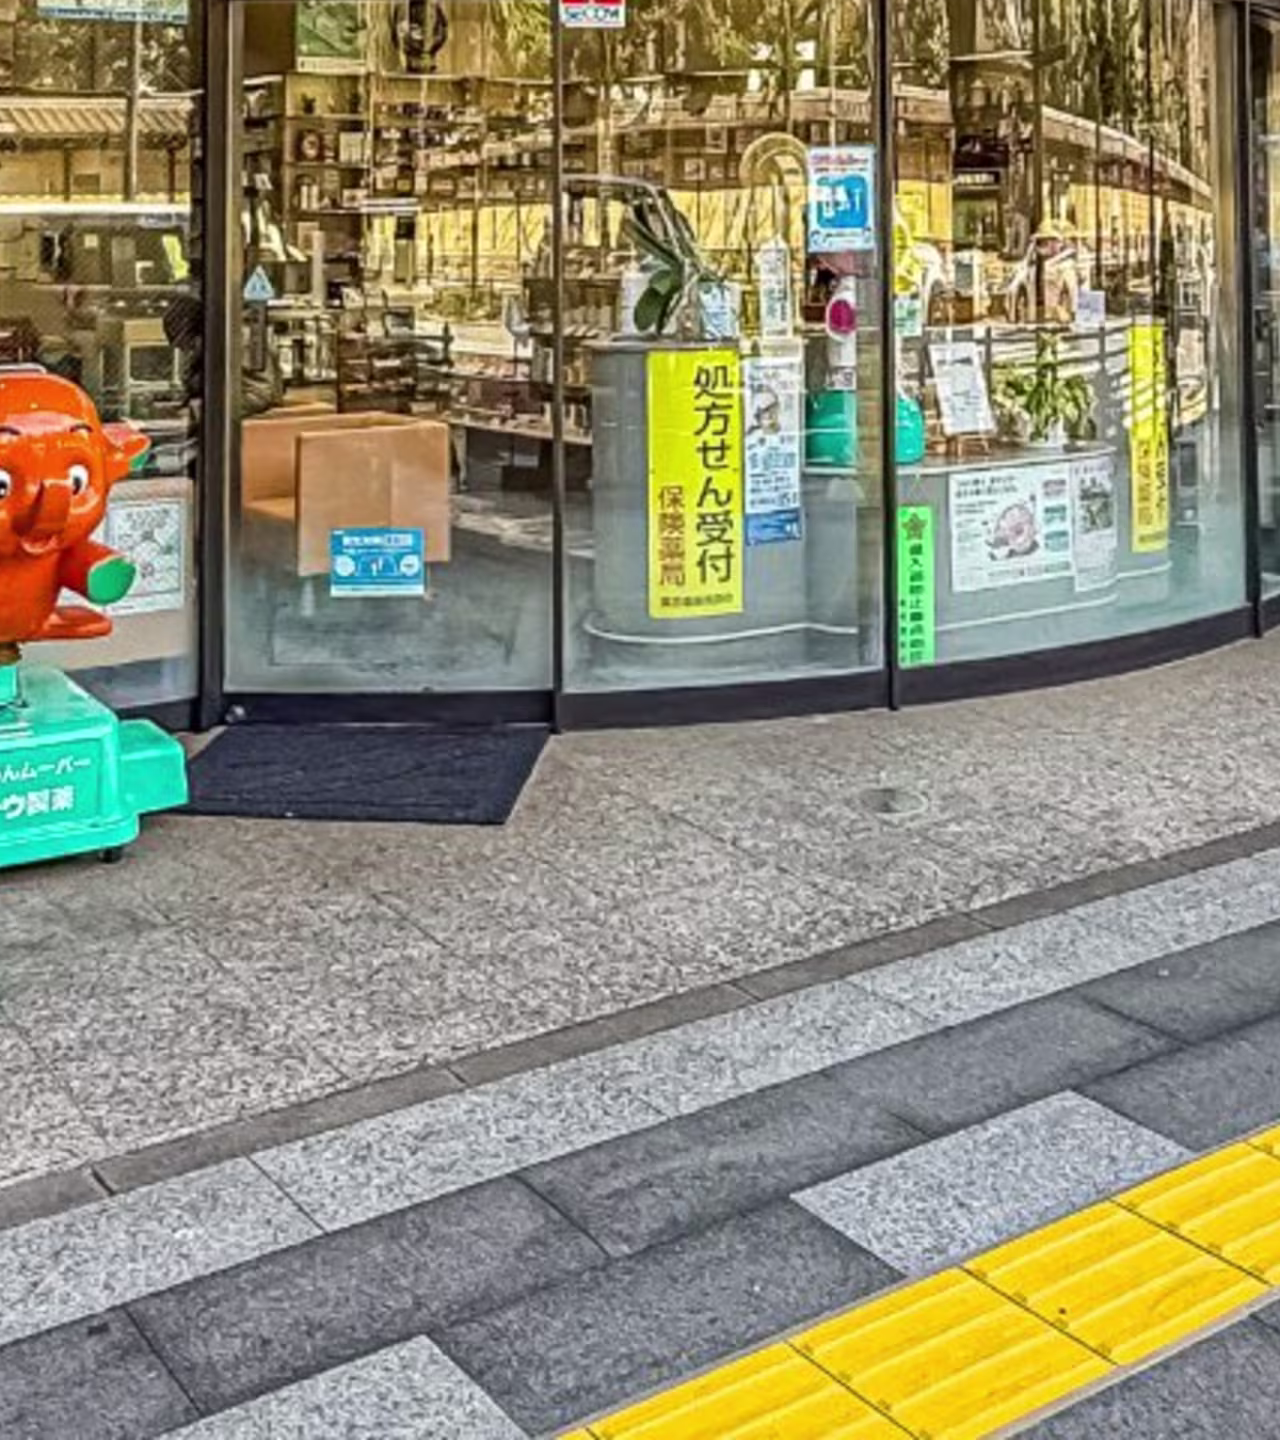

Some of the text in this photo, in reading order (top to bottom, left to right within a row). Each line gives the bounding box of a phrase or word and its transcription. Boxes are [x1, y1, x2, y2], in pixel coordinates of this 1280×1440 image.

[694, 365, 734, 584] 処方せん受付
